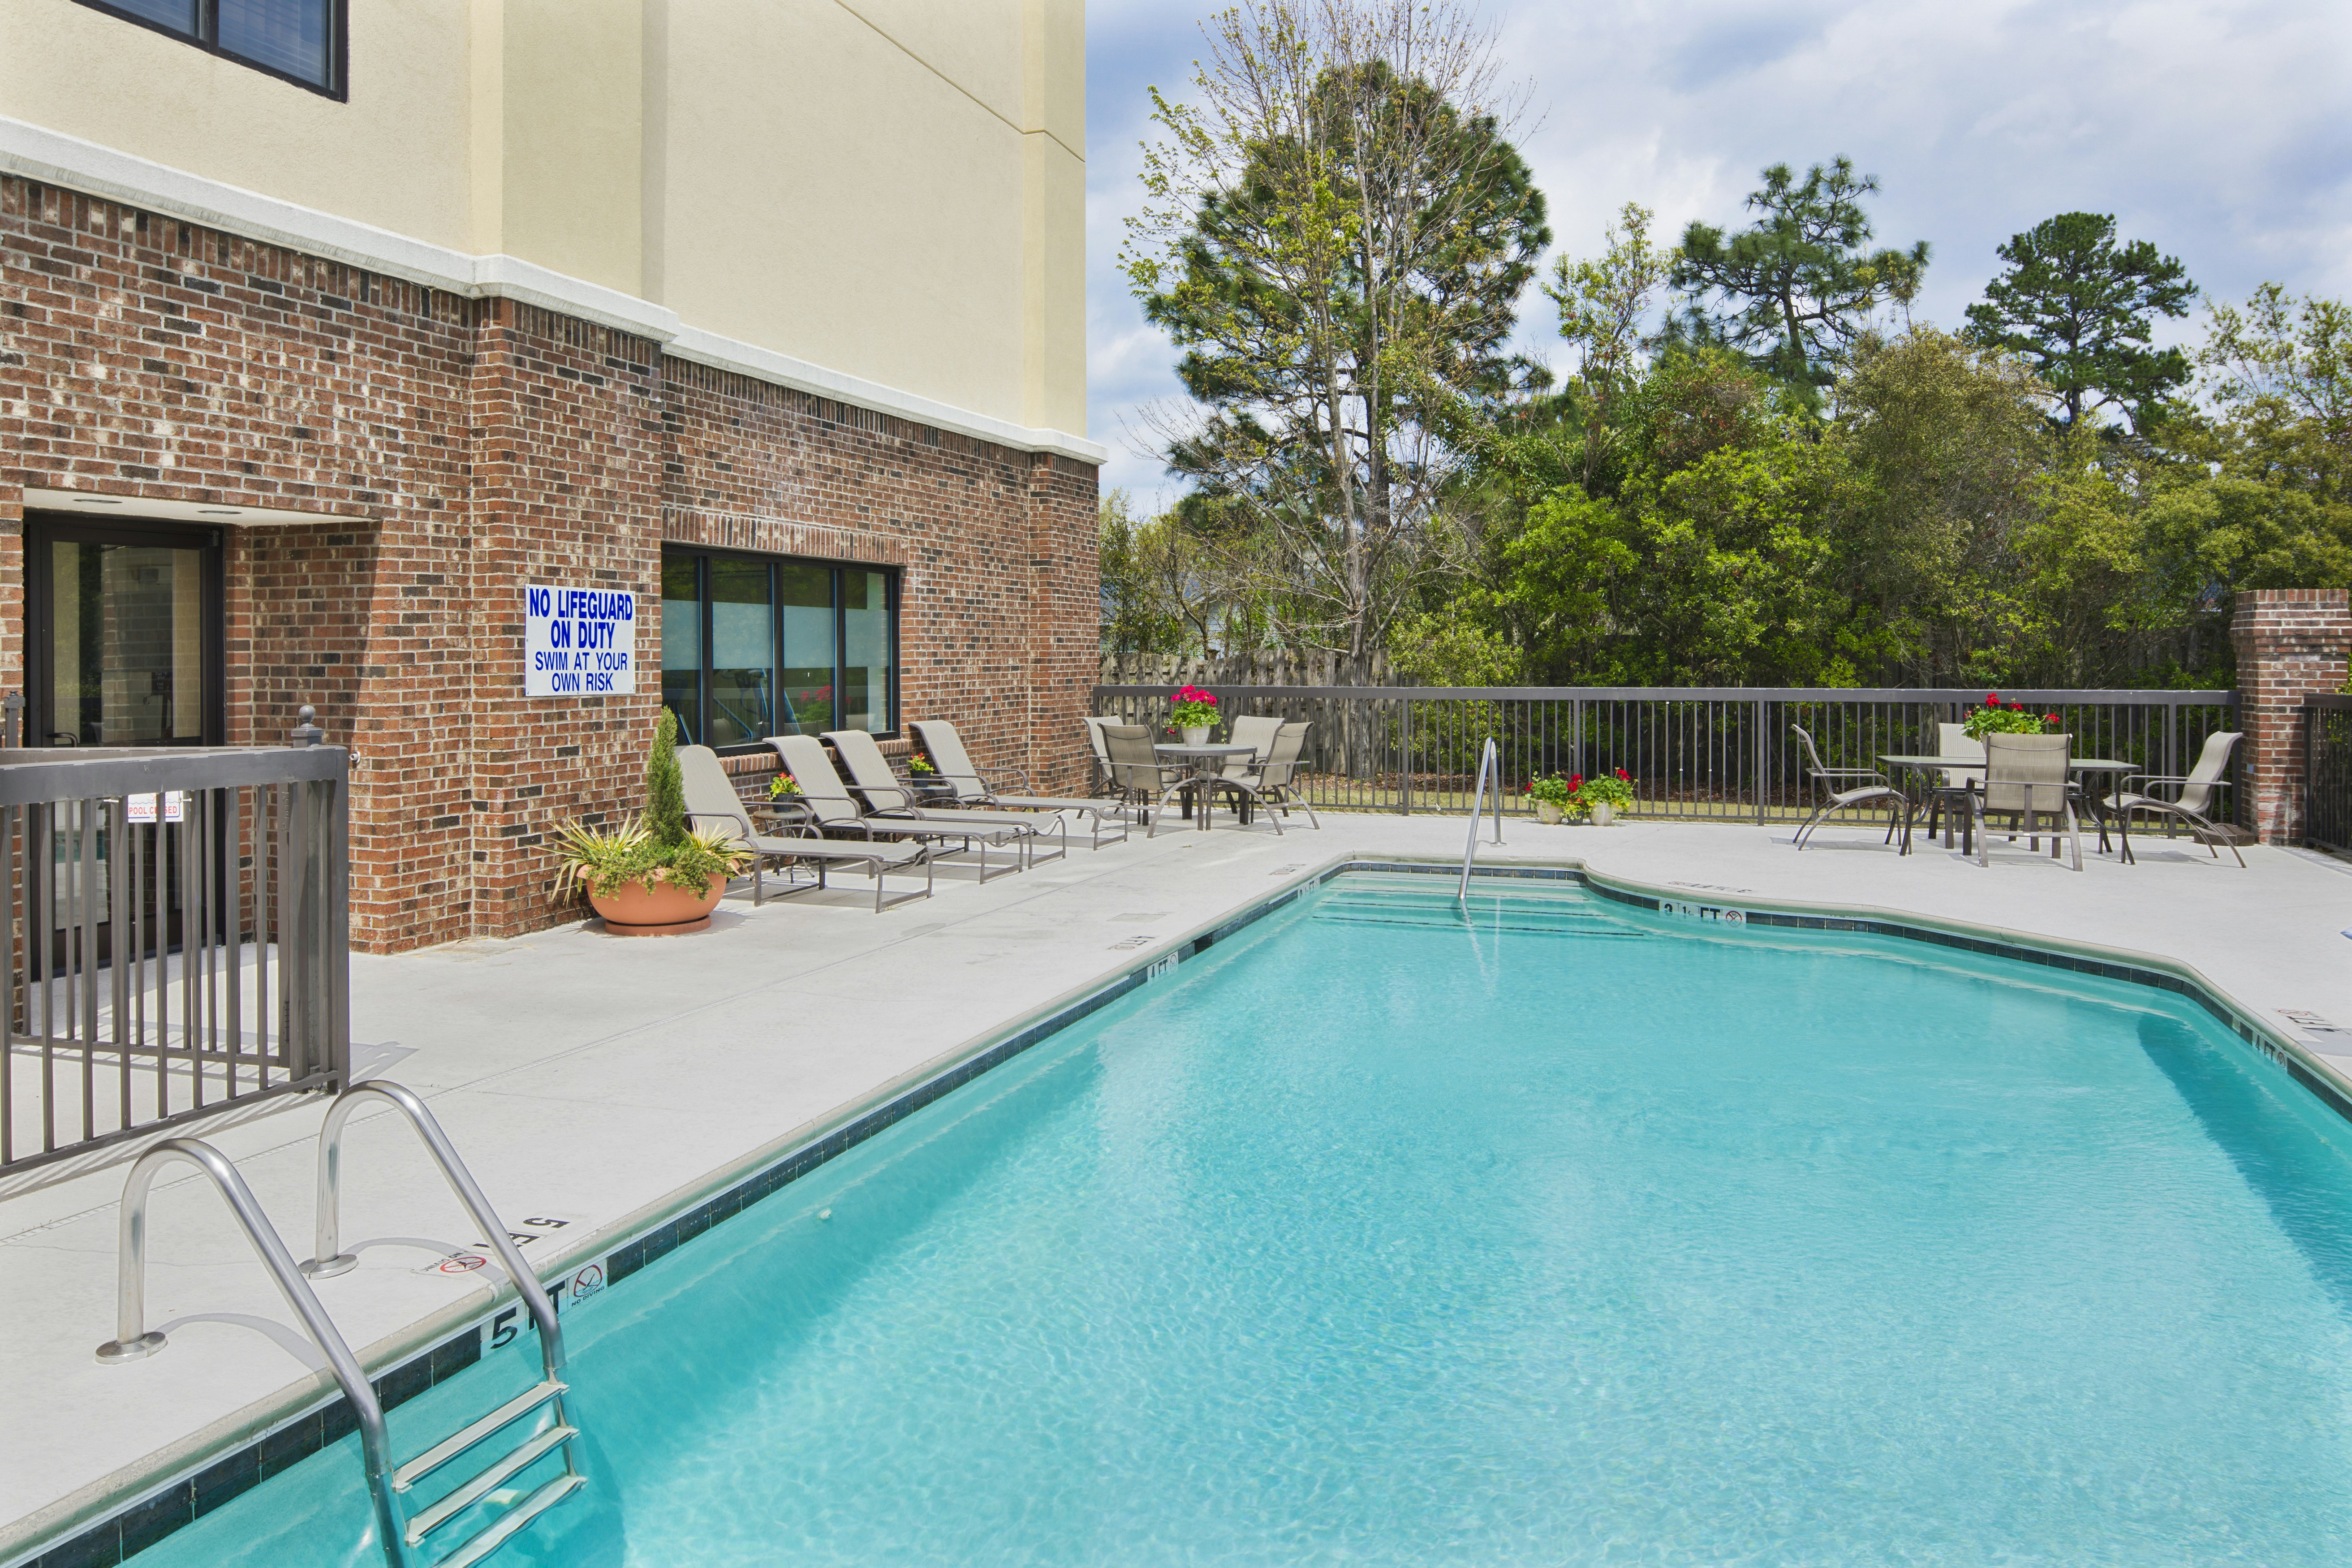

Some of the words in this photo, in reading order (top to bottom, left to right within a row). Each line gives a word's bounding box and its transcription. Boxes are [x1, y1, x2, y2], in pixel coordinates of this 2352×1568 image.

[530, 588, 550, 617] NO
[558, 590, 633, 620] LIFEGUARD
[551, 620, 570, 648] ON
[578, 621, 615, 649] DUTY
[535, 651, 568, 671] SWIM
[574, 652, 590, 670] AT
[596, 653, 628, 671] YOUR
[552, 673, 579, 692] OWN
[586, 673, 613, 691] RISK
[150, 806, 177, 814] CLSED
[1700, 907, 1721, 919] FT
[1151, 965, 1155, 978] 4
[1159, 958, 1168, 975] FT
[2286, 1016, 2333, 1026] FT
[2255, 1034, 2260, 1051] 4
[2264, 1040, 2275, 1061] FT
[523, 1218, 570, 1228] 5
[420, 1258, 450, 1272] DIVING
[583, 1286, 605, 1300] DIVING
[490, 1307, 518, 1349] 5
